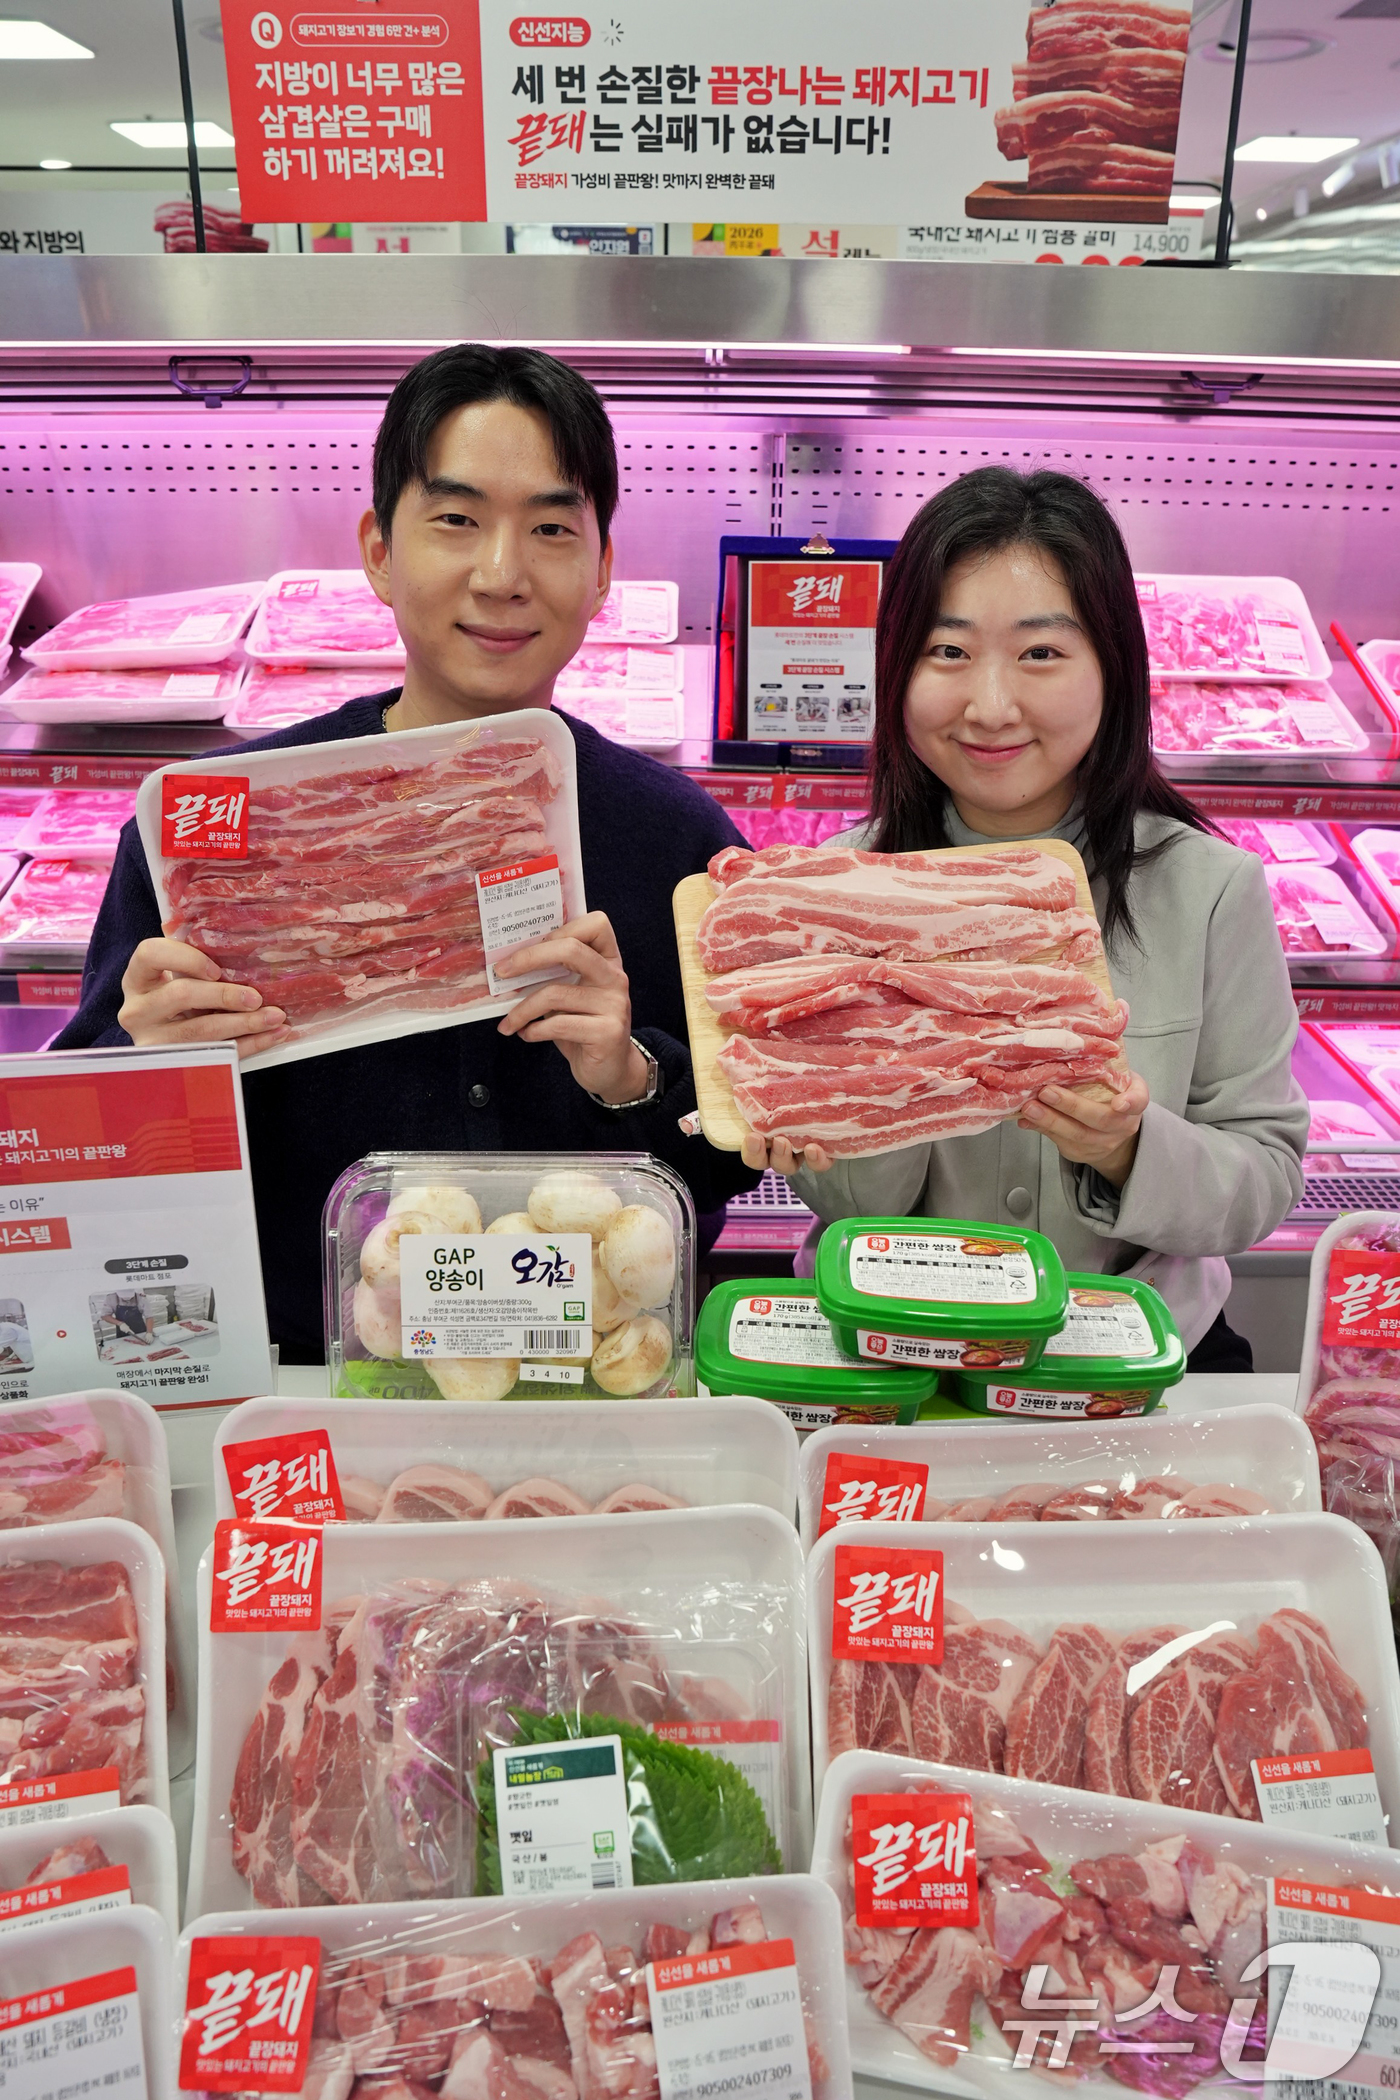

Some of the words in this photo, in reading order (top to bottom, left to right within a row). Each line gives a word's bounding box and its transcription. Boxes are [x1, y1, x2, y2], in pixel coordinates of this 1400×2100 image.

[257, 17, 275, 43] Q
[298, 24, 335, 38] 돼지고기
[337, 24, 365, 38] 장보기
[366, 24, 385, 38] 경험
[386, 24, 403, 38] 6만
[421, 25, 440, 39] 분석
[517, 21, 585, 43] 신선지능
[255, 61, 340, 97] 지방이
[347, 62, 403, 96] 너무
[408, 62, 465, 96] 많은
[511, 65, 544, 105] 세
[554, 65, 587, 105] 번
[596, 65, 701, 105] 손질한
[706, 65, 845, 106] 끝장나는
[853, 67, 989, 108] 돼지고기
[258, 104, 371, 139] 삼겹살은
[376, 104, 432, 139] 구매
[631, 113, 735, 154] 실패가
[743, 115, 891, 155] 없습니다!
[263, 147, 318, 181] 하기
[324, 147, 444, 181] 꺼려져요!
[514, 172, 568, 190] 끝장돼지
[570, 173, 611, 190] 가성비
[613, 173, 659, 190] 끝판왕!
[662, 173, 703, 190] 맛까지
[705, 173, 747, 190] 완벽한
[748, 174, 776, 190] 끝돼
[730, 227, 763, 239] 2026
[23, 231, 84, 254] 지방의
[1134, 233, 1189, 253] 14,900
[786, 575, 844, 611] 끝돼
[165, 792, 246, 839] 끝돼
[192, 841, 222, 849] 돼지고기의
[207, 832, 241, 841] 끝장돼지
[6, 1147, 79, 1165] 돼지고기의
[82, 1144, 127, 1160] 끝판왕
[893, 1242, 930, 1250] 간편한
[932, 1244, 957, 1252] 쌈장
[126, 1259, 149, 1270] 3단계
[150, 1258, 167, 1268] 손질
[434, 1248, 475, 1265] GAP
[511, 1247, 574, 1287] 오감
[426, 1269, 484, 1291] 양송이
[774, 1303, 810, 1313] 간편한
[1337, 1327, 1359, 1336] 맛있는
[1359, 1329, 1395, 1338] 돼지고기의
[892, 1344, 931, 1357] 간편한
[933, 1348, 960, 1360] 쌈장
[116, 1369, 152, 1379] 매장에서
[154, 1366, 182, 1376] 마지막
[183, 1364, 211, 1375] 손질로
[120, 1379, 157, 1389] 돼지고기
[158, 1376, 186, 1387] 끝판왕
[187, 1375, 209, 1385] 완성!
[1020, 1397, 1058, 1409] 간편한
[1060, 1401, 1086, 1411] 쌈장
[806, 1413, 832, 1423] 쌈장
[235, 1448, 328, 1519] 끝돼
[293, 1498, 334, 1514] 끝장돼지
[216, 1538, 318, 1606] 끝돼
[268, 1594, 312, 1607] 끝장돼지
[837, 1571, 940, 1633] 끝돼
[225, 1608, 248, 1618] 맛있는
[249, 1608, 288, 1618] 돼지고기의
[289, 1607, 312, 1617] 끝판왕
[892, 1624, 934, 1639] 끝장돼지
[848, 1635, 871, 1647] 맛있는
[872, 1637, 910, 1648] 돼지고기의
[911, 1638, 934, 1650] 끝판왕
[658, 1727, 688, 1740] 신선을
[1262, 1763, 1291, 1777] 신선을
[1293, 1760, 1321, 1774] 새롭게
[22, 1782, 56, 1798] 새롭게
[510, 1830, 533, 1844] 깻잎
[857, 1817, 969, 1896] 끝돼
[25, 1886, 63, 1906] 새롭게
[920, 1882, 968, 1898] 끝장돼지
[1279, 1886, 1312, 1904] 신선을
[1315, 1892, 1350, 1910] 새롭게
[872, 1899, 898, 1910] 맛있는
[899, 1899, 942, 1910] 돼지고기의
[943, 1899, 969, 1910] 끝판왕
[659, 1963, 694, 1984] 신선을
[696, 1955, 732, 1975] 새롭게
[25, 1989, 65, 2014] 새롭게
[188, 1964, 313, 2056] 끝돼
[249, 2040, 299, 2059] 끝장돼지
[697, 2064, 792, 2096] 905002407309
